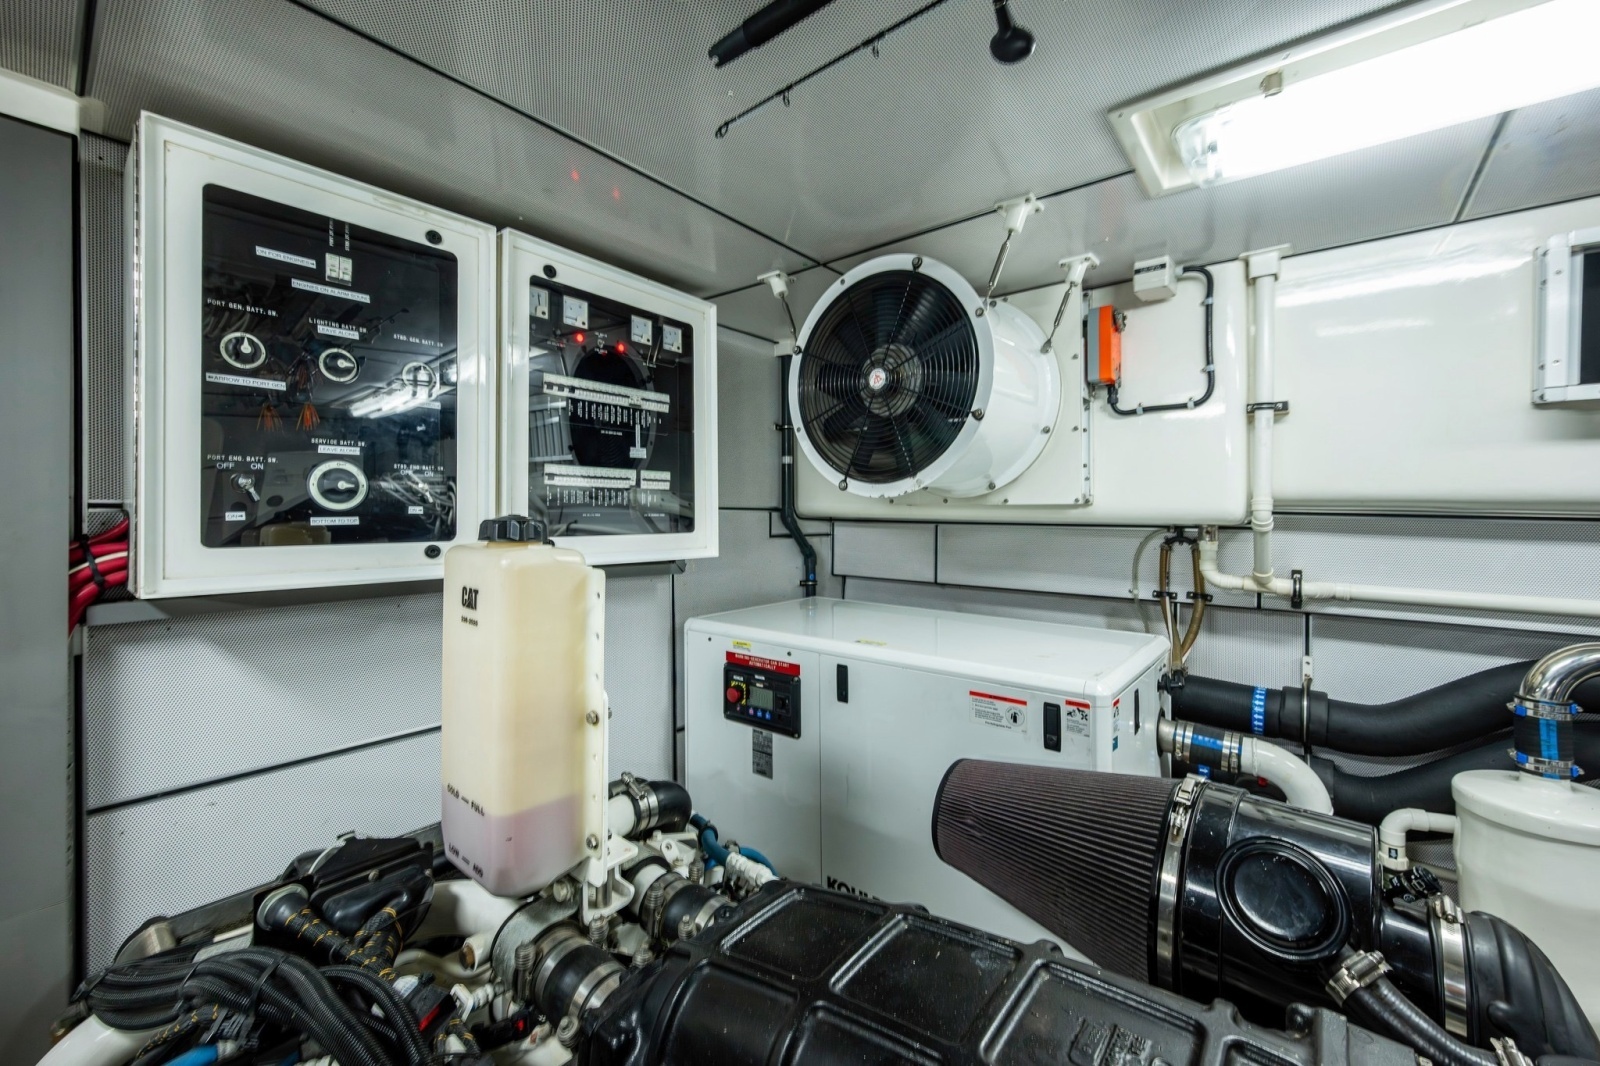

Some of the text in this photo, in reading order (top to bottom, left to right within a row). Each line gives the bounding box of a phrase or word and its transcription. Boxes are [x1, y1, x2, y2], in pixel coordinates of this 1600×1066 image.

[256, 247, 267, 256] ON
[207, 298, 226, 307] PORT
[308, 317, 340, 329] LIGHTING
[310, 438, 338, 446] SERVICE
[216, 462, 264, 471] OFF ON
[461, 586, 479, 611] CAT
[447, 782, 485, 817] COLD FULL
[448, 842, 484, 879] LOW ADD
